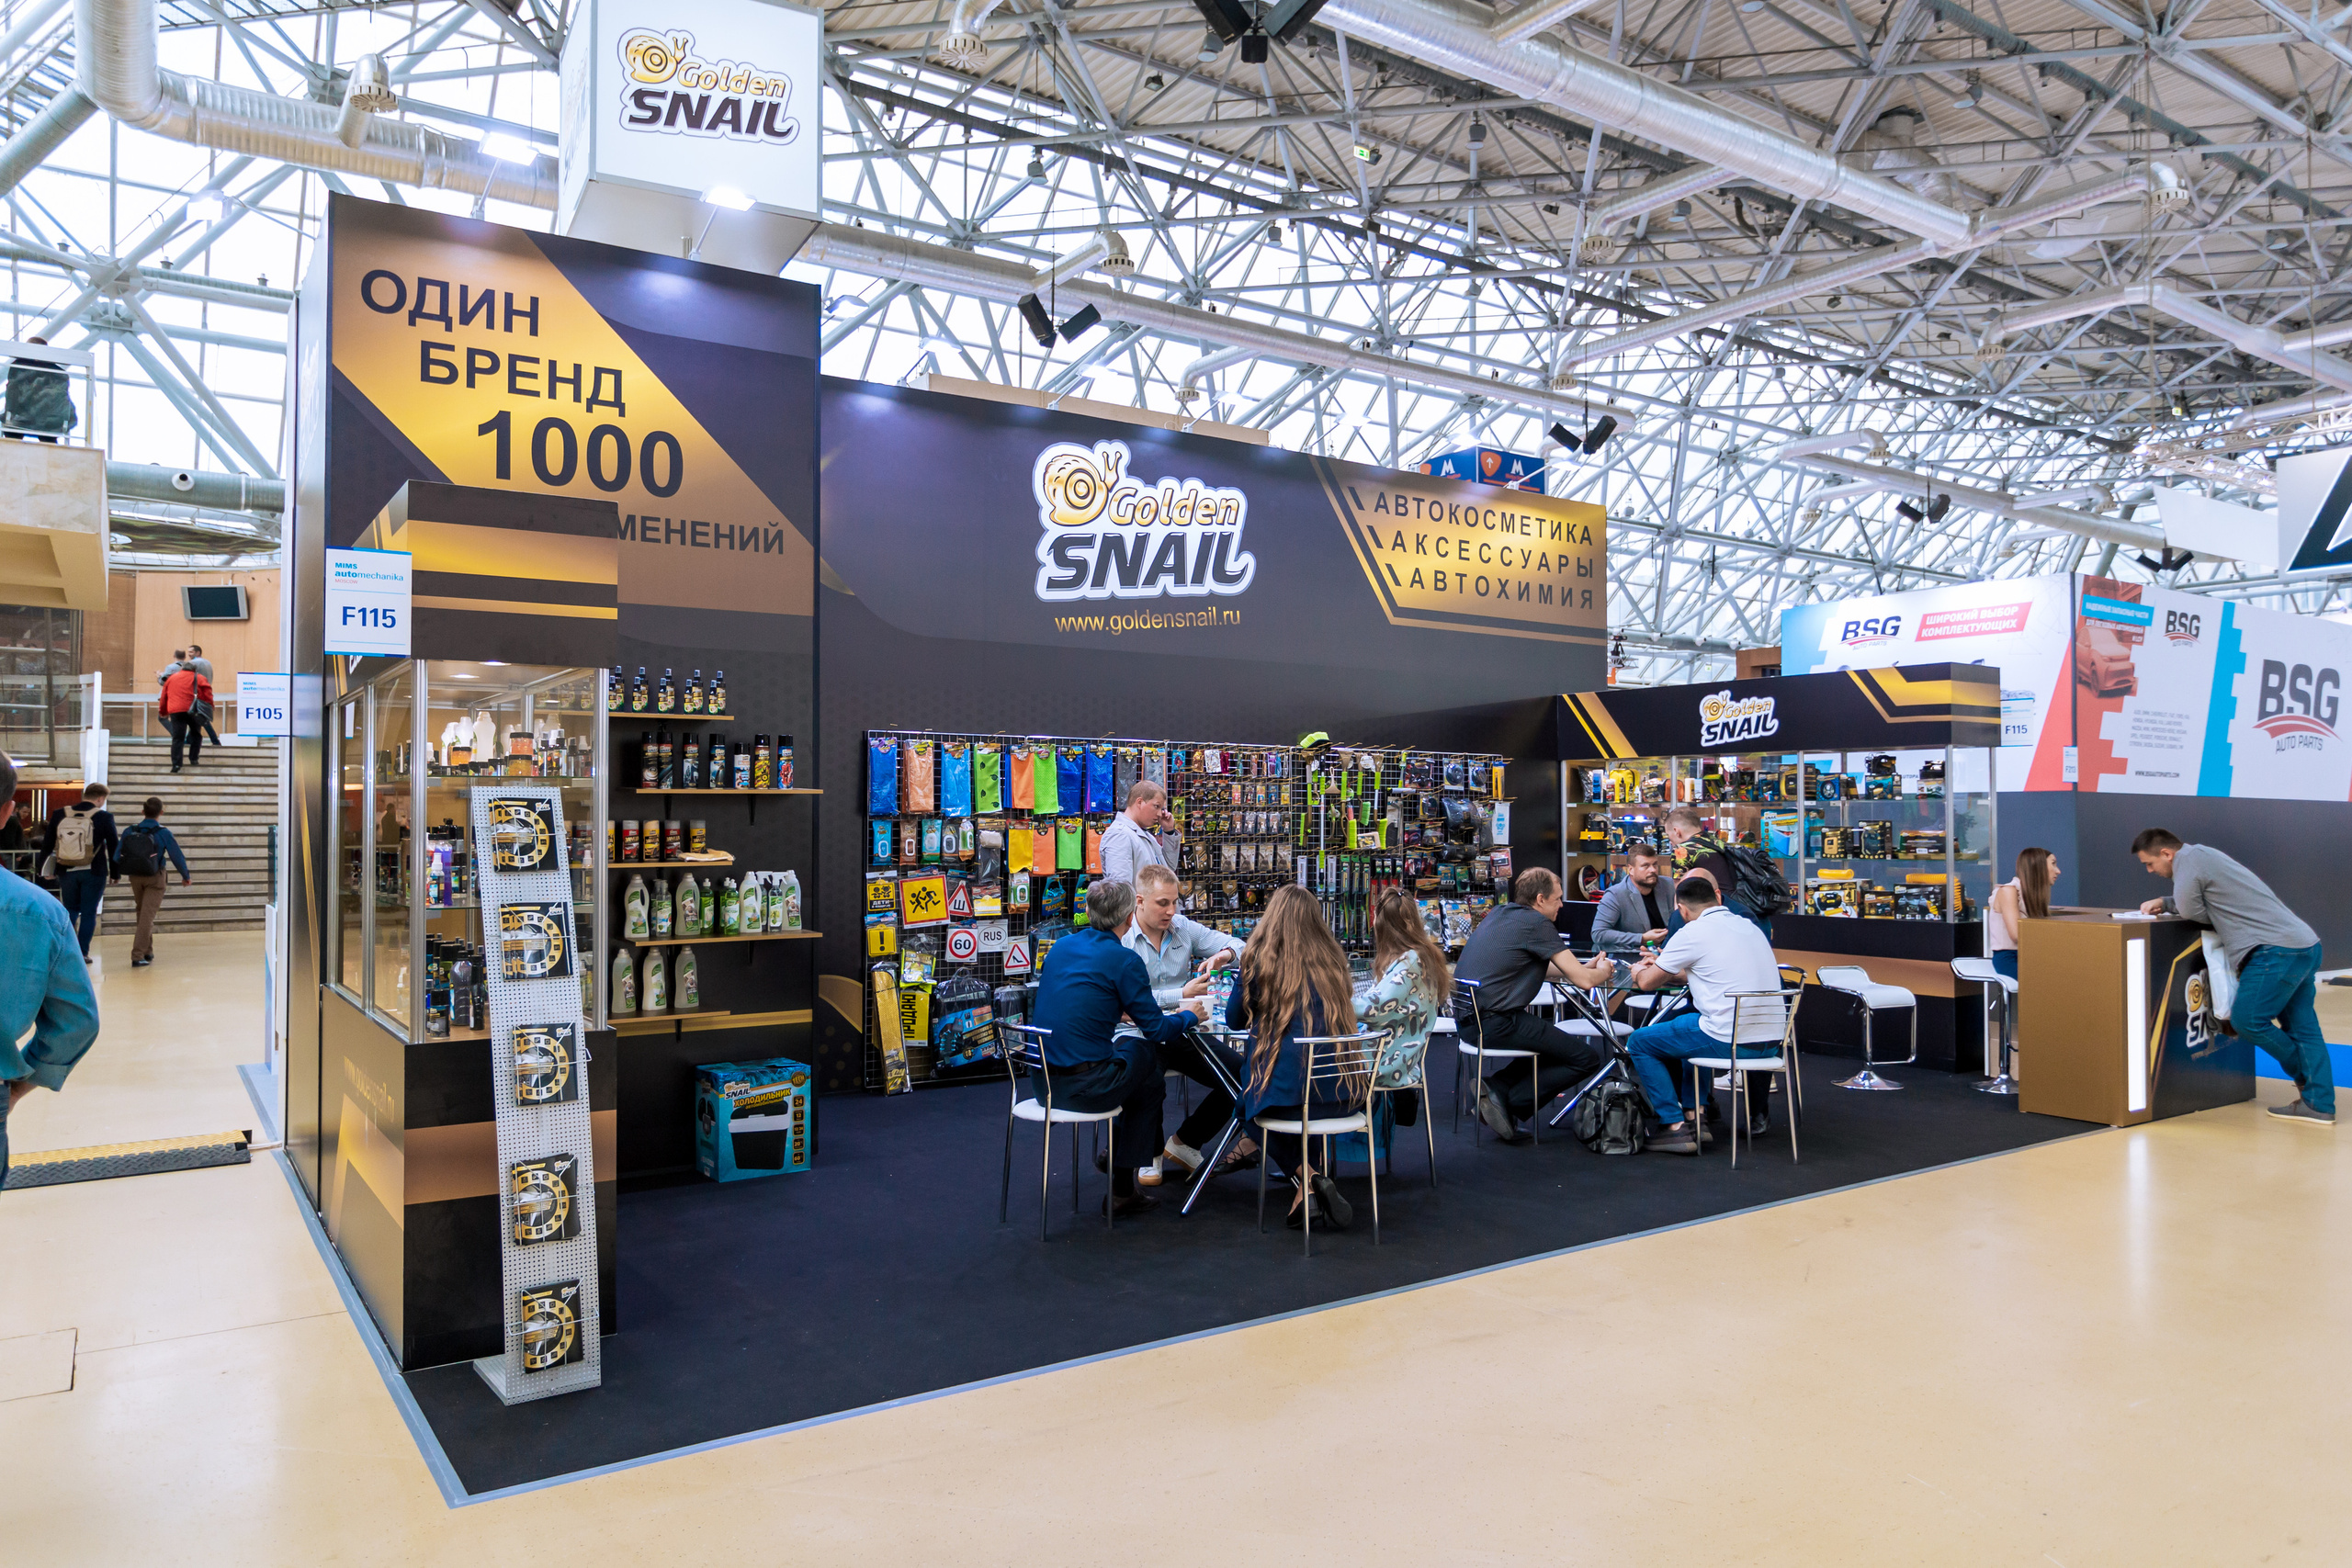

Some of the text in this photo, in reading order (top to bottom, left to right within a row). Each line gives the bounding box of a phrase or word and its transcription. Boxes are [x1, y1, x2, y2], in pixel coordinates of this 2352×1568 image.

[678, 62, 786, 97] Golden
[628, 87, 794, 138] SNAIL
[360, 269, 539, 336] ОДИН
[420, 339, 626, 417] БРЕНД
[478, 410, 684, 498] 1000
[1108, 487, 1239, 526] Golden
[1374, 491, 1592, 546] АВТОКОСМЕТИКА
[617, 513, 784, 555] МЕНЕНИЙ
[1046, 531, 1249, 592] SNAIL
[1391, 530, 1592, 579] АКСЕССУАРЫ
[334, 570, 404, 581] automechanika
[1409, 567, 1592, 610] АВТОХИМИЯ
[342, 605, 396, 628] F115
[1055, 606, 1240, 636] www.goldensnail.ru
[1841, 615, 1902, 642] BSG
[1921, 618, 2018, 637] КОМПЛЕКТУЮЩИХ
[1926, 605, 2019, 626] ШИРОКИЙ ВЫБОР
[2165, 610, 2200, 639] BSG
[1852, 642, 1868, 650] AUTO
[2257, 659, 2340, 728] BSG
[245, 707, 283, 719] F105
[1724, 701, 1771, 718] Golden
[1703, 712, 1777, 743] SNAIL
[2005, 725, 2028, 734] F115
[2276, 735, 2323, 754] AUTO PARTS
[955, 939, 971, 950] 60
[983, 931, 1002, 942] RUS
[901, 995, 916, 1038] ПРОДАЮ
[726, 1089, 750, 1099] SNAIL
[734, 1088, 791, 1108] ХОЛОДИЛЬНИК
